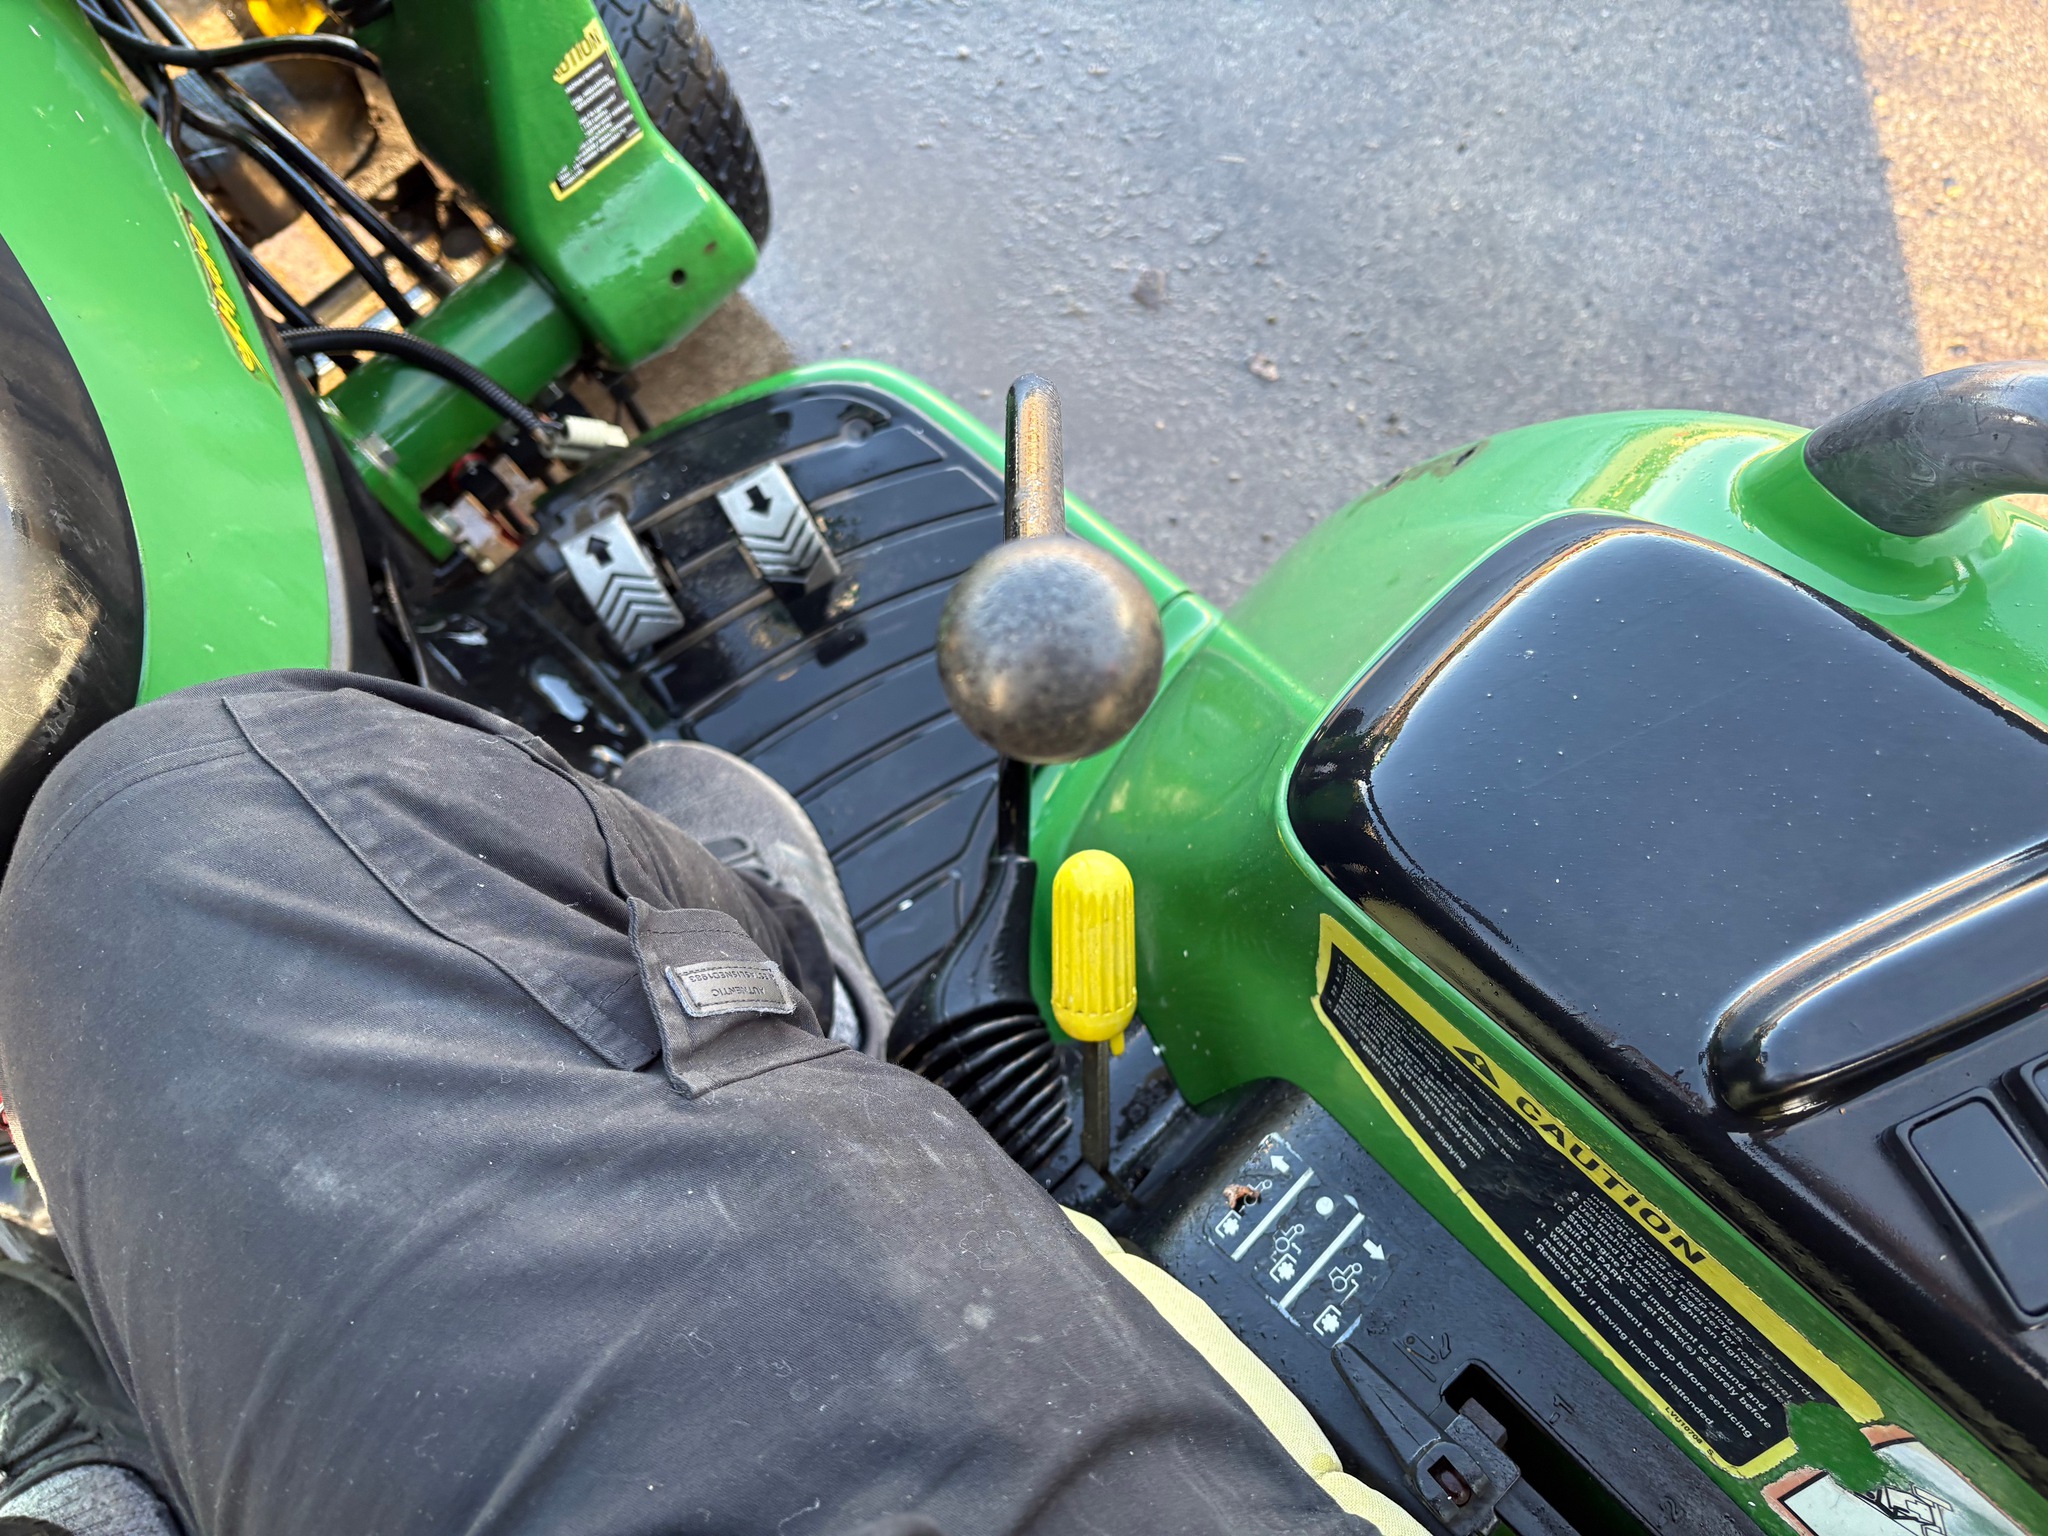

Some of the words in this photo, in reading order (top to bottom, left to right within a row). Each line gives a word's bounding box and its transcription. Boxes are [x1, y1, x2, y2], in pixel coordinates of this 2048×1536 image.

[711, 985, 765, 996] AUTHENTIC
[1346, 964, 1367, 984] Read
[1413, 1026, 1443, 1055] Manual
[1445, 1056, 1472, 1082] before
[1474, 1084, 1514, 1122] operating
[1517, 1123, 1531, 1140] this
[1359, 1006, 1386, 1036] starting
[1391, 1041, 1417, 1068] engine
[1416, 1067, 1426, 1077] or
[1409, 1032, 1417, 1041] in
[1418, 1042, 1441, 1066] place.
[1339, 998, 1356, 1020] Keep
[1357, 1019, 1381, 1047] hands,
[1383, 1047, 1397, 1064] feet
[1397, 1065, 1412, 1081] and
[1412, 1081, 1442, 1116] clothing
[1442, 1116, 1462, 1138] away
[1462, 1138, 1481, 1159] from
[1340, 993, 1359, 1014] Keep
[1360, 1015, 1369, 1025] all
[1370, 1026, 1391, 1050] riders
[1393, 1050, 1404, 1062] off
[1404, 1062, 1429, 1089] tractor
[1429, 1091, 1444, 1107] and
[1444, 1108, 1485, 1154] equipment.
[1360, 1040, 1381, 1065] speed
[1381, 1065, 1400, 1088] when
[1400, 1088, 1426, 1123] turning
[1426, 1120, 1435, 1129] or
[1435, 1131, 1466, 1168] applying
[1379, 1056, 1400, 1080] parts.
[1393, 1036, 1426, 1070] everyone
[1427, 1071, 1434, 1080] is
[1436, 1080, 1456, 1100] clear
[1456, 1102, 1468, 1110] of
[1466, 1112, 1499, 1148] machine
[1500, 1148, 1514, 1162] be-
[1401, 1031, 1423, 1053] loads
[1424, 1054, 1442, 1072] only
[1444, 1072, 1452, 1082] to
[1453, 1083, 1486, 1116] drawbar
[1488, 1117, 1497, 1126] to
[1498, 1127, 1521, 1150] avoid
[1516, 1096, 1706, 1264] CAUTION
[1555, 1226, 1609, 1284] dismounting.
[1572, 1210, 1619, 1255] prohibited
[1619, 1255, 1632, 1267] by
[1633, 1268, 1650, 1288] law.
[1524, 1230, 1534, 1244] 12.
[1536, 1243, 1570, 1280] Remove
[1571, 1280, 1587, 1297] key
[1595, 1305, 1628, 1340] leaving
[1628, 1340, 1660, 1370] tractor
[1660, 1372, 1714, 1428] unattended.
[1536, 1217, 1546, 1231] 11.
[1550, 1231, 1569, 1253] Wait
[1569, 1253, 1583, 1266] for
[1583, 1268, 1596, 1279] all
[1595, 1280, 1642, 1328] movement
[1643, 1328, 1653, 1338] to
[1654, 1340, 1675, 1361] stop
[1676, 1361, 1707, 1392] before
[1708, 1394, 1752, 1438] servicing
[1542, 1238, 1587, 1287] machinery.
[1553, 1202, 1564, 1214] 10.
[1567, 1214, 1588, 1236] Stop
[1589, 1237, 1620, 1267] engine
[1621, 1268, 1647, 1293] lower
[1648, 1294, 1698, 1343] implement
[1698, 1344, 1709, 1354] to
[1709, 1356, 1747, 1390] ground
[1746, 1392, 1767, 1410] and
[1561, 1221, 1582, 1241] shift
[1582, 1241, 1592, 1251] to
[1630, 1289, 1641, 1299] or
[1641, 1301, 1657, 1316] set
[1657, 1316, 1696, 1355] brake(s)
[1697, 1356, 1738, 1395] securely
[1739, 1397, 1771, 1428] before
[1578, 1205, 1596, 1222] Use
[1597, 1220, 1634, 1260] flashing
[1636, 1260, 1674, 1298] warning
[1675, 1298, 1702, 1325] lights
[1704, 1326, 1717, 1339] on
[1718, 1340, 1760, 1379] highway
[1583, 1200, 1618, 1231] Couple
[1617, 1232, 1643, 1258] brake
[1644, 1260, 1676, 1290] pedals
[1678, 1291, 1720, 1329] together
[1721, 1332, 1736, 1345] for
[1737, 1347, 1763, 1369] road
[1587, 1197, 1599, 1208] on
[1601, 1210, 1629, 1236] rough
[1630, 1238, 1666, 1270] ground
[1667, 1272, 1678, 1281] or
[1680, 1284, 1707, 1309] steep
[1709, 1311, 1743, 1345] slopes.
[1591, 1194, 1637, 1235] individual
[1639, 1237, 1671, 1267] brakes
[1673, 1269, 1685, 1278] or
[1686, 1281, 1734, 1325] operating
[1774, 1362, 1816, 1400] hazards
